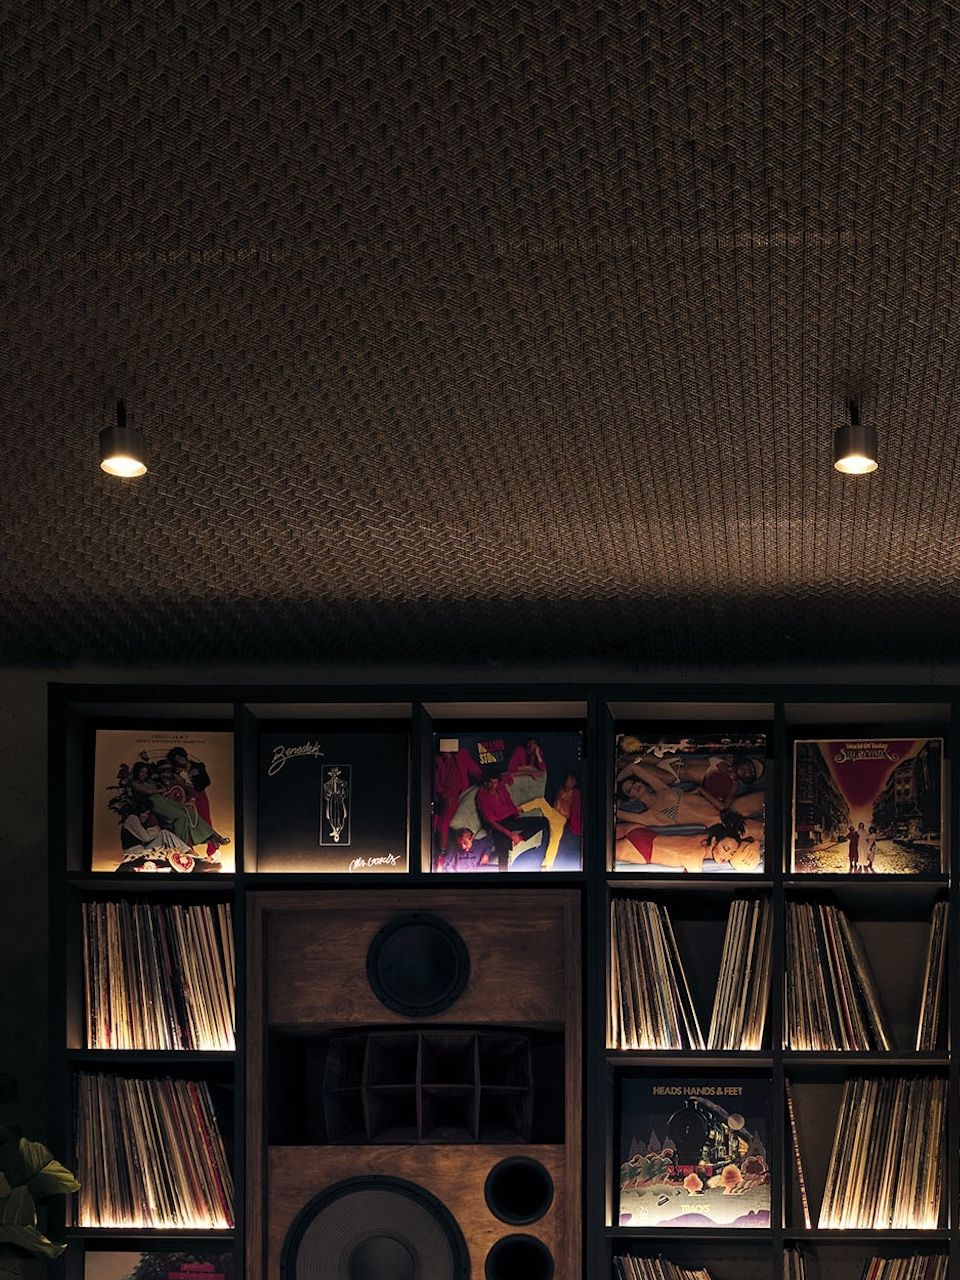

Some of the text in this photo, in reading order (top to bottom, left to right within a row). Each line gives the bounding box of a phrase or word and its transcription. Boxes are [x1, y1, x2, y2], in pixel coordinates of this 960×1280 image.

[653, 1086, 743, 1096] HEADS HANDS & FEET
[681, 1204, 710, 1213] TRACKS
